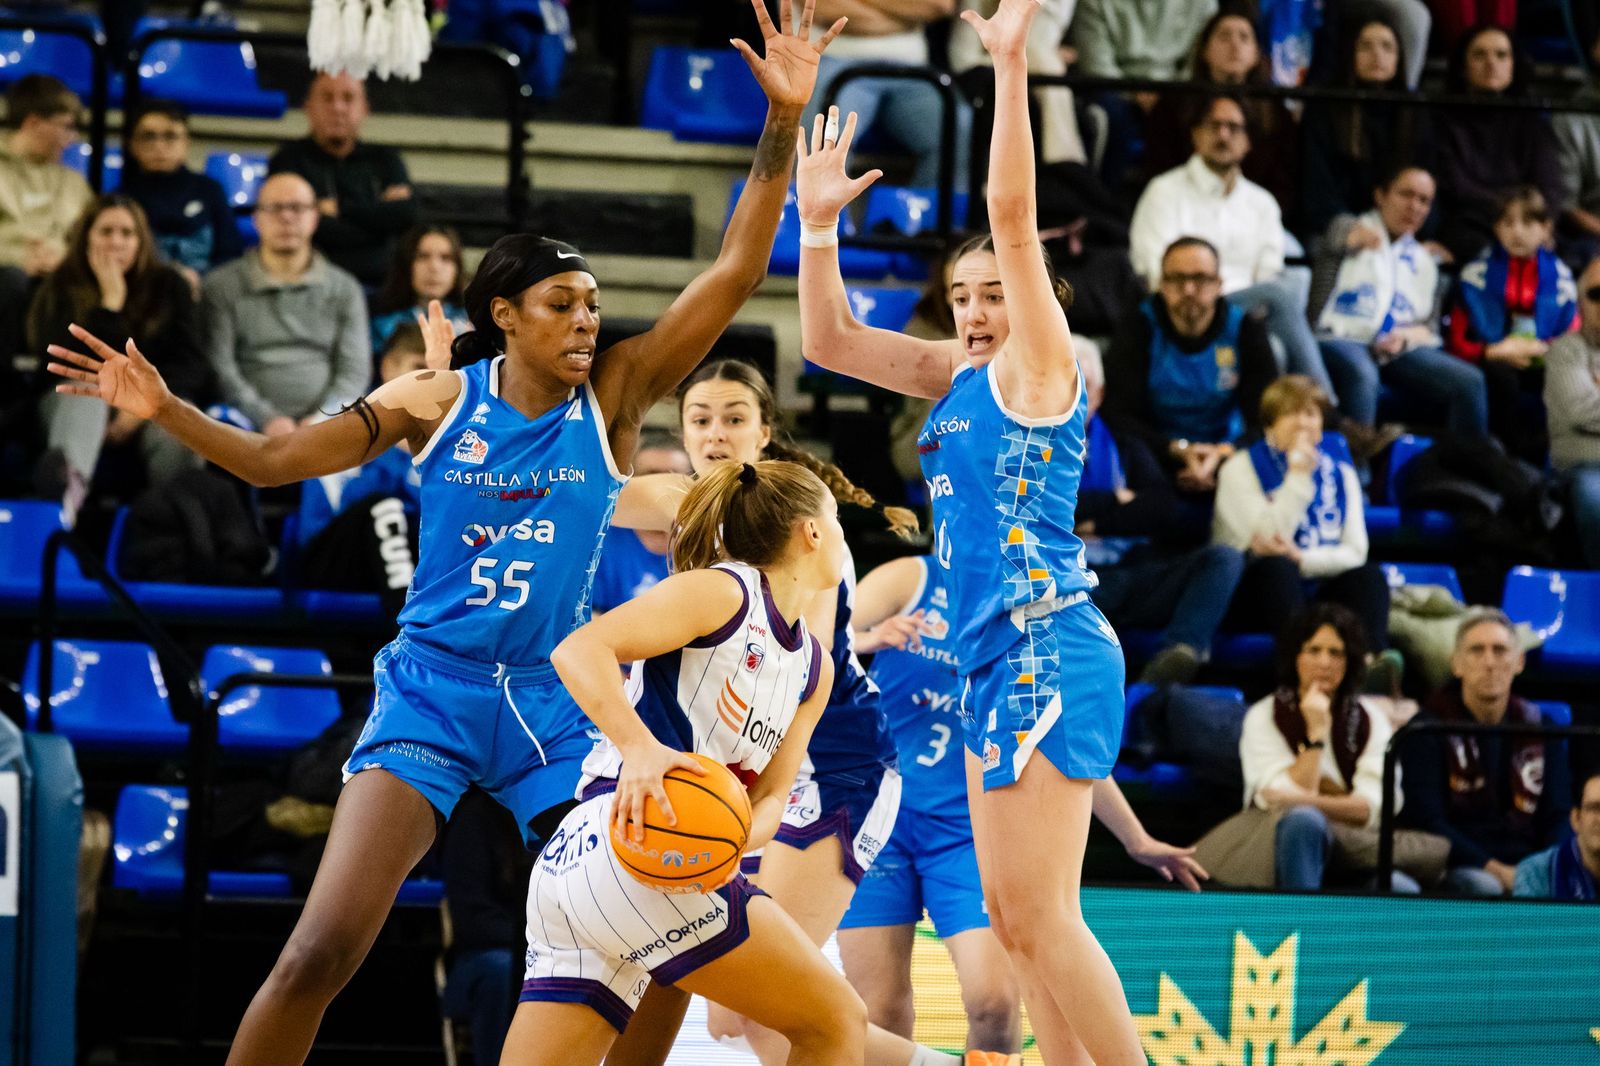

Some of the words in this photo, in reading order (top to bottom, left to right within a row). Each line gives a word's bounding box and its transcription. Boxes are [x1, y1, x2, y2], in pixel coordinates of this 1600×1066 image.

[933, 416, 970, 436] LEÓN
[444, 469, 522, 487] CASTILLA
[530, 471, 541, 487] Y
[548, 464, 586, 483] LEÓN
[466, 557, 535, 611] 55
[916, 722, 952, 768] 3
[666, 906, 724, 943] ORTASA
